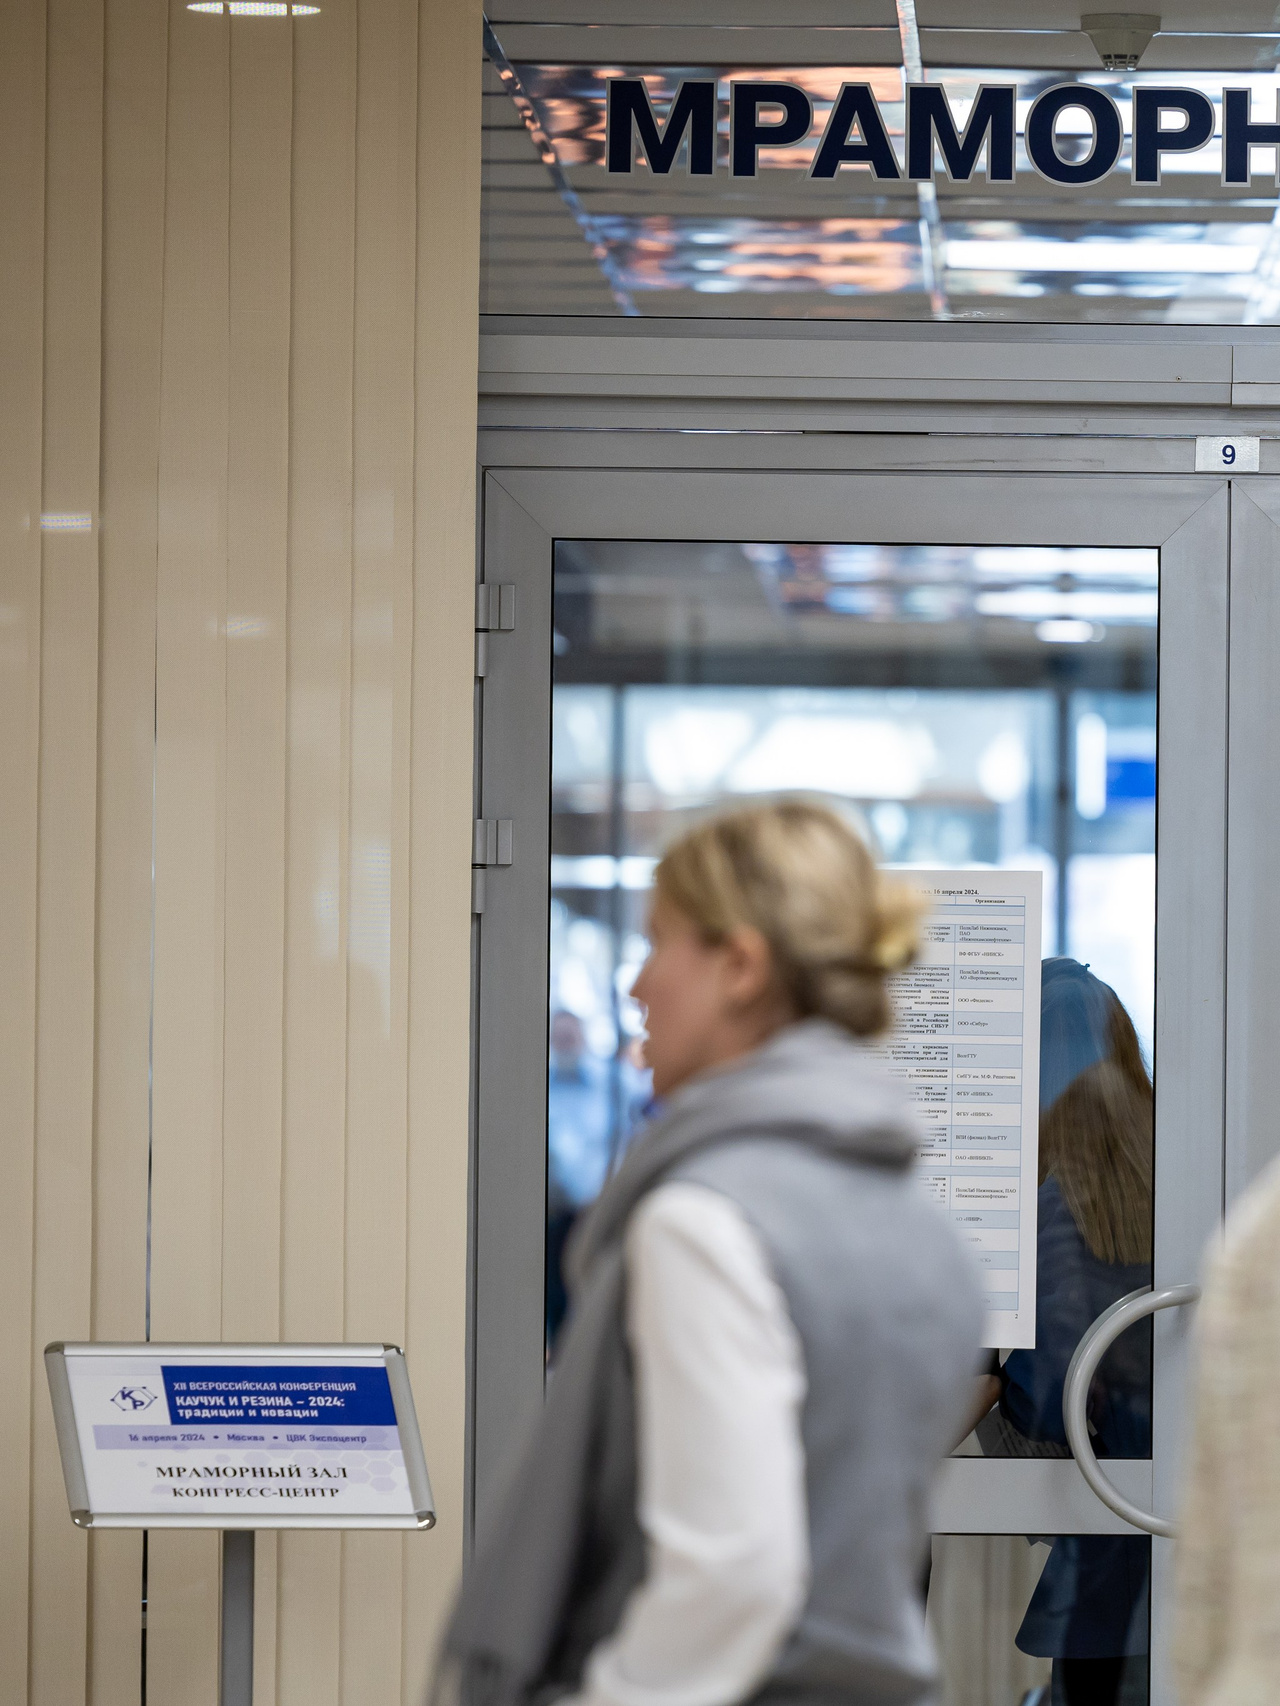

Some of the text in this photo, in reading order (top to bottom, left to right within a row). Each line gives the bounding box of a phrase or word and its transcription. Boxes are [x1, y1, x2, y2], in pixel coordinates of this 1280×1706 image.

[1222, 444, 1236, 465] 9
[189, 1380, 277, 1391] ВСЕРОССИЙСКАЯ
[279, 1381, 357, 1392] КОНФЕРЕНЦИЯ
[175, 1396, 226, 1406] КАУЧУК
[232, 1396, 239, 1406] И
[241, 1396, 293, 1406] РЕЗИНА
[308, 1396, 345, 1407] 2024:
[177, 1409, 319, 1419] традиции и новации
[128, 1434, 138, 1442] 16
[142, 1434, 178, 1443] апреля
[286, 1434, 306, 1443] ЦВК
[309, 1434, 367, 1444] Экспоцентр
[155, 1464, 348, 1479] МРАМОРНЫЙ ЗАЛ
[172, 1487, 340, 1499] КОНГРЕСС-ЦЕНТР
